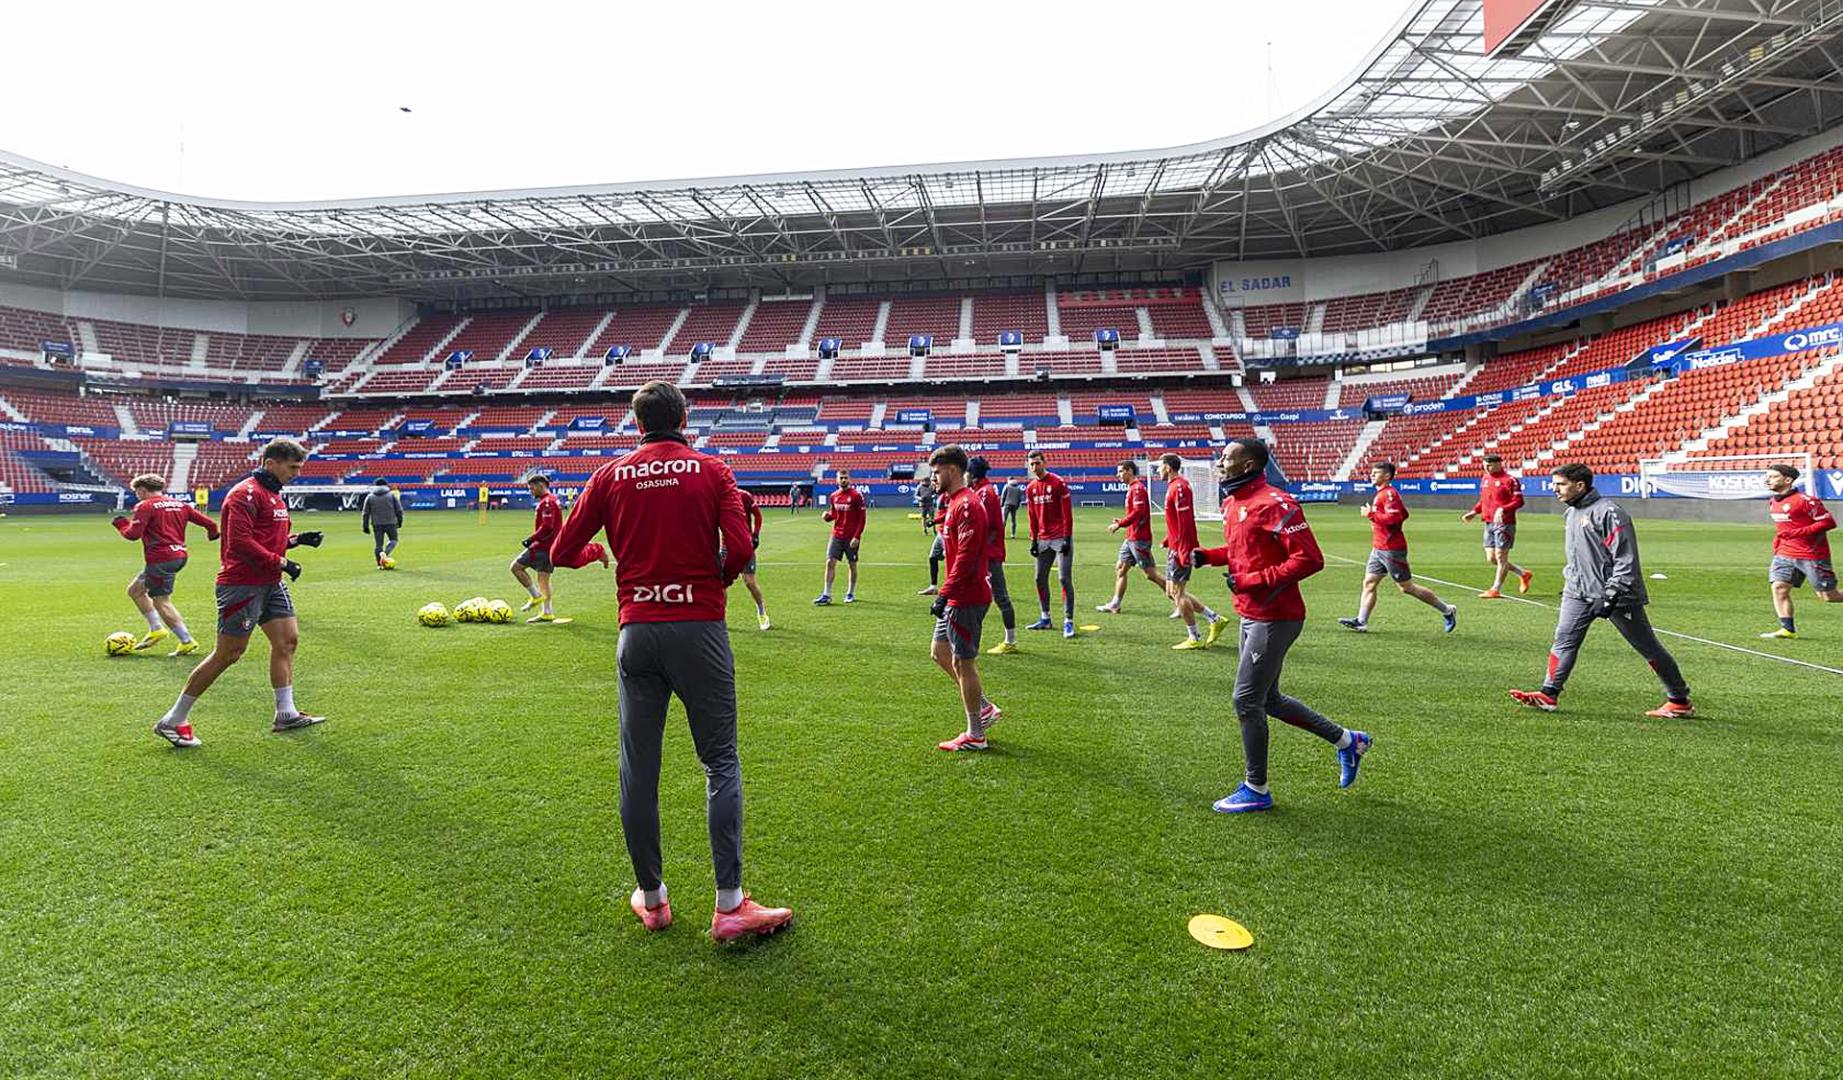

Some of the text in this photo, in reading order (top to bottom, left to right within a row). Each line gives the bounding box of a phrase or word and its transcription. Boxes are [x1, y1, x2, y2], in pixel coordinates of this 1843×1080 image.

[1220, 276, 1291, 293] EL SADAR
[1808, 327, 1840, 343] mrc
[614, 459, 700, 481] macron
[636, 478, 680, 490] OSASUNA
[1708, 475, 1766, 489] kosne
[632, 584, 693, 603] DIGI
